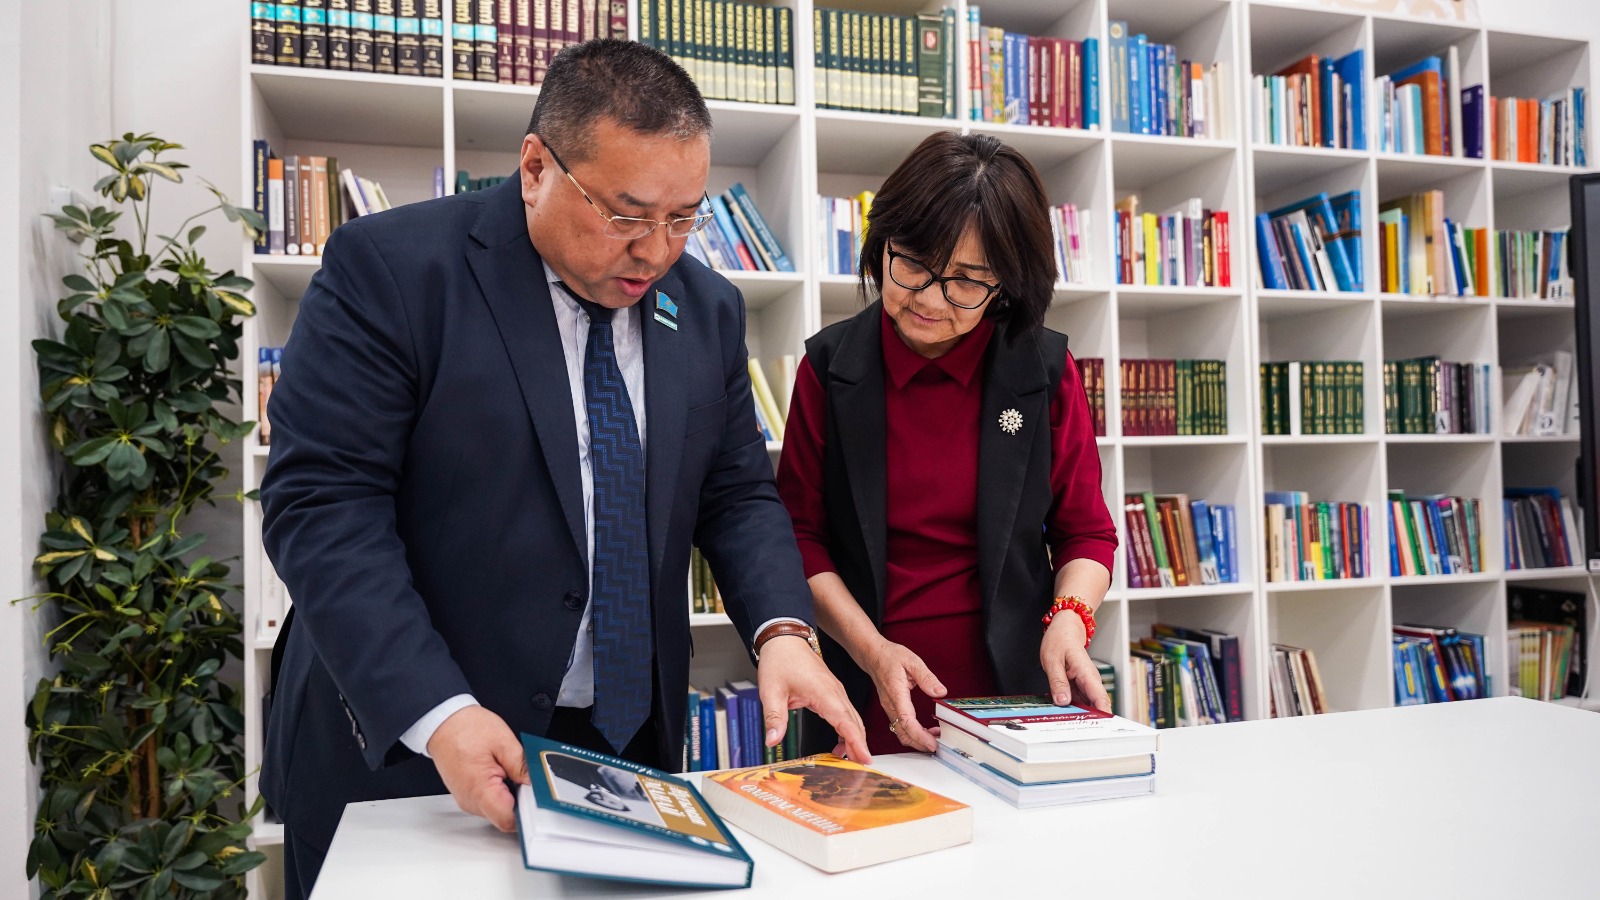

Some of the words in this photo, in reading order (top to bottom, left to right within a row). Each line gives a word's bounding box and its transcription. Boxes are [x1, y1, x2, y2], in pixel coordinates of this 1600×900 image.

[284, 37, 292, 47] 2
[310, 40, 318, 49] 3
[336, 43, 343, 52] 4
[359, 44, 367, 53] 5
[382, 47, 390, 56] 6
[519, 47, 527, 56] 2
[459, 55, 467, 63] 9
[536, 50, 543, 59] 3
[691, 716, 701, 761] ФИЛОСОФИЯ
